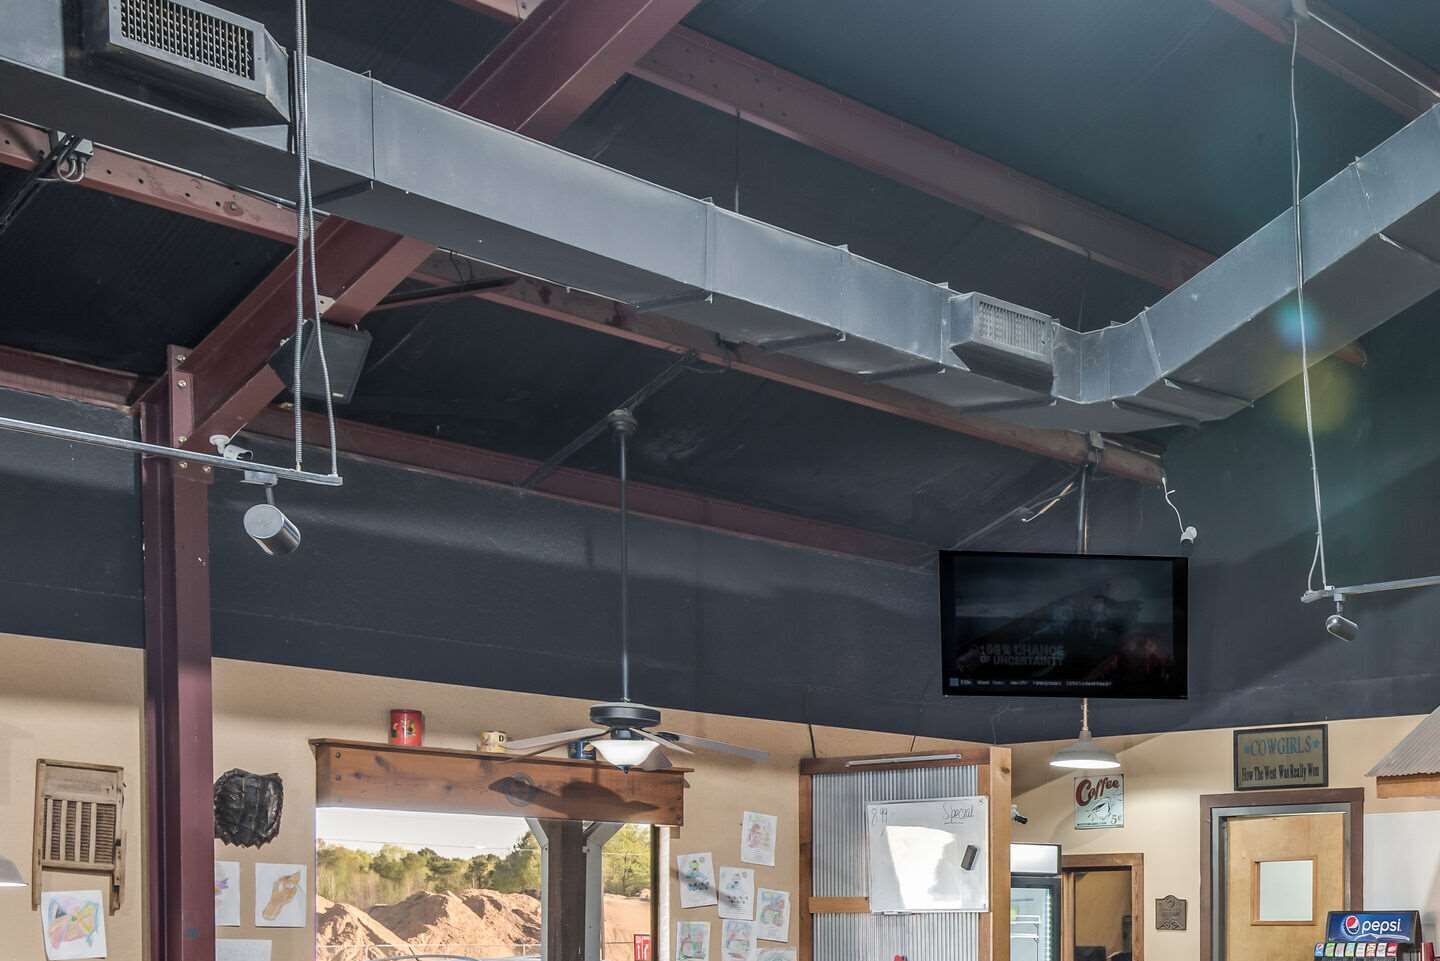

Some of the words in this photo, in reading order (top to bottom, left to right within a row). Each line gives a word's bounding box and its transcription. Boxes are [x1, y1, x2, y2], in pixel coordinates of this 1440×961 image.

[1251, 736, 1312, 756] COWGIRLS
[1076, 777, 1120, 806] Coffee
[1362, 919, 1401, 934] pepsi
